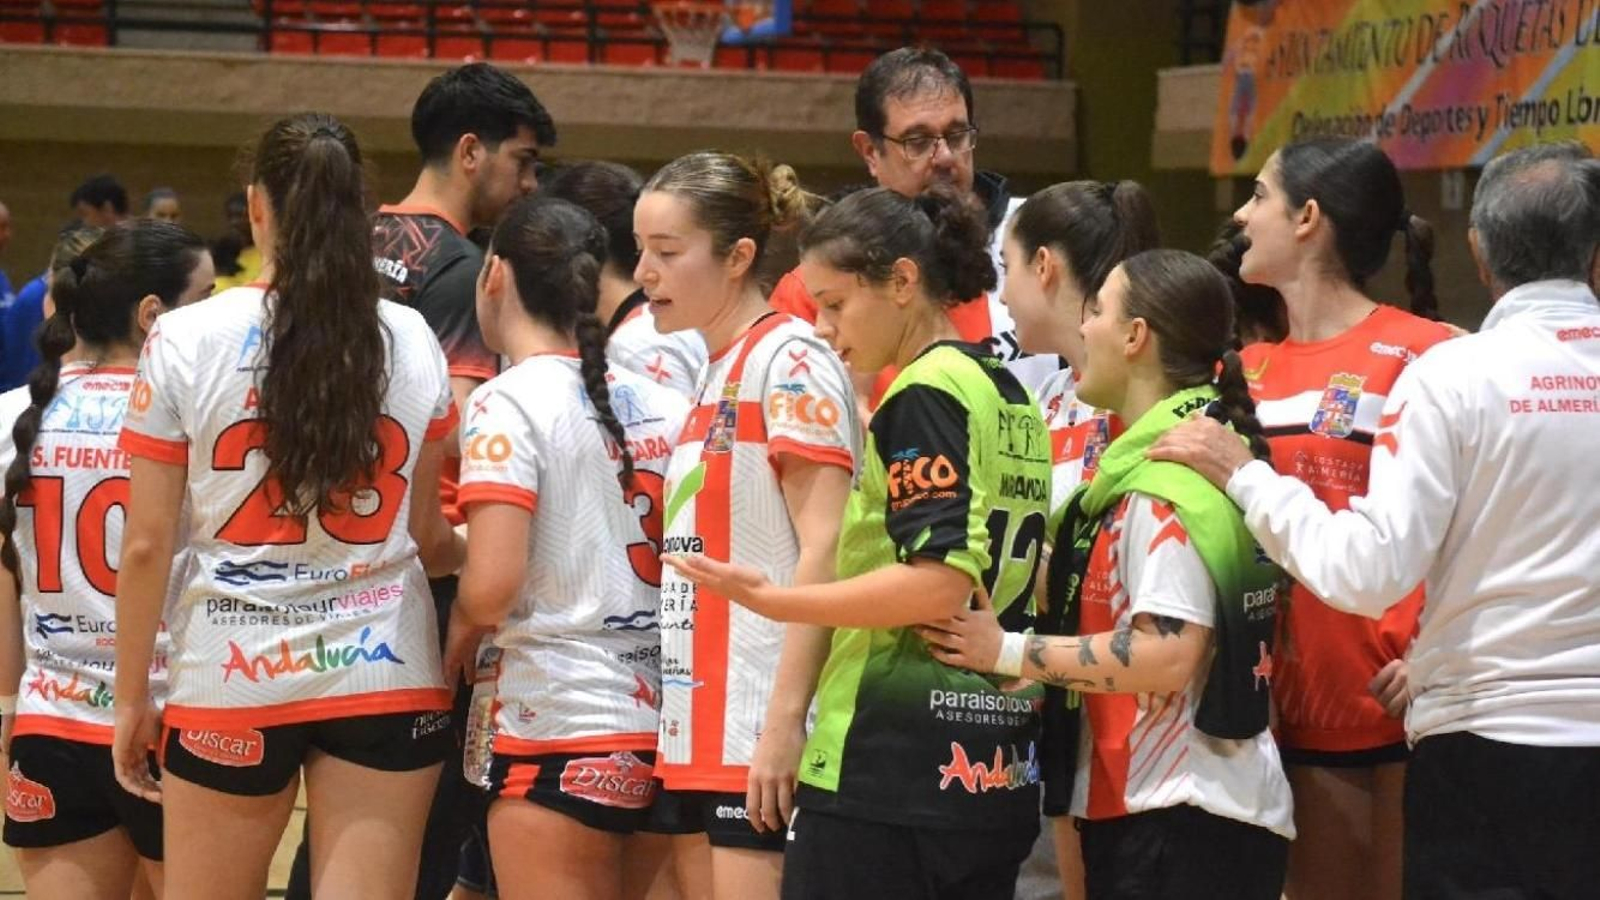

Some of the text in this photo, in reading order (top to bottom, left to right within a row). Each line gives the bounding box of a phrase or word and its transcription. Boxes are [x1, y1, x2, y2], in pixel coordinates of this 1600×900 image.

[1413, 11, 1449, 63] DE
[1475, 104, 1488, 141] y
[1495, 92, 1560, 136] Tiempo
[1510, 399, 1532, 413] DE
[17, 476, 131, 598] 10
[617, 468, 665, 588] 3
[294, 560, 388, 583] EuroFi
[980, 508, 1047, 633] 12
[661, 595, 699, 612] ERÍA
[219, 626, 406, 684] Andalucía
[935, 709, 1005, 726] ASESORES
